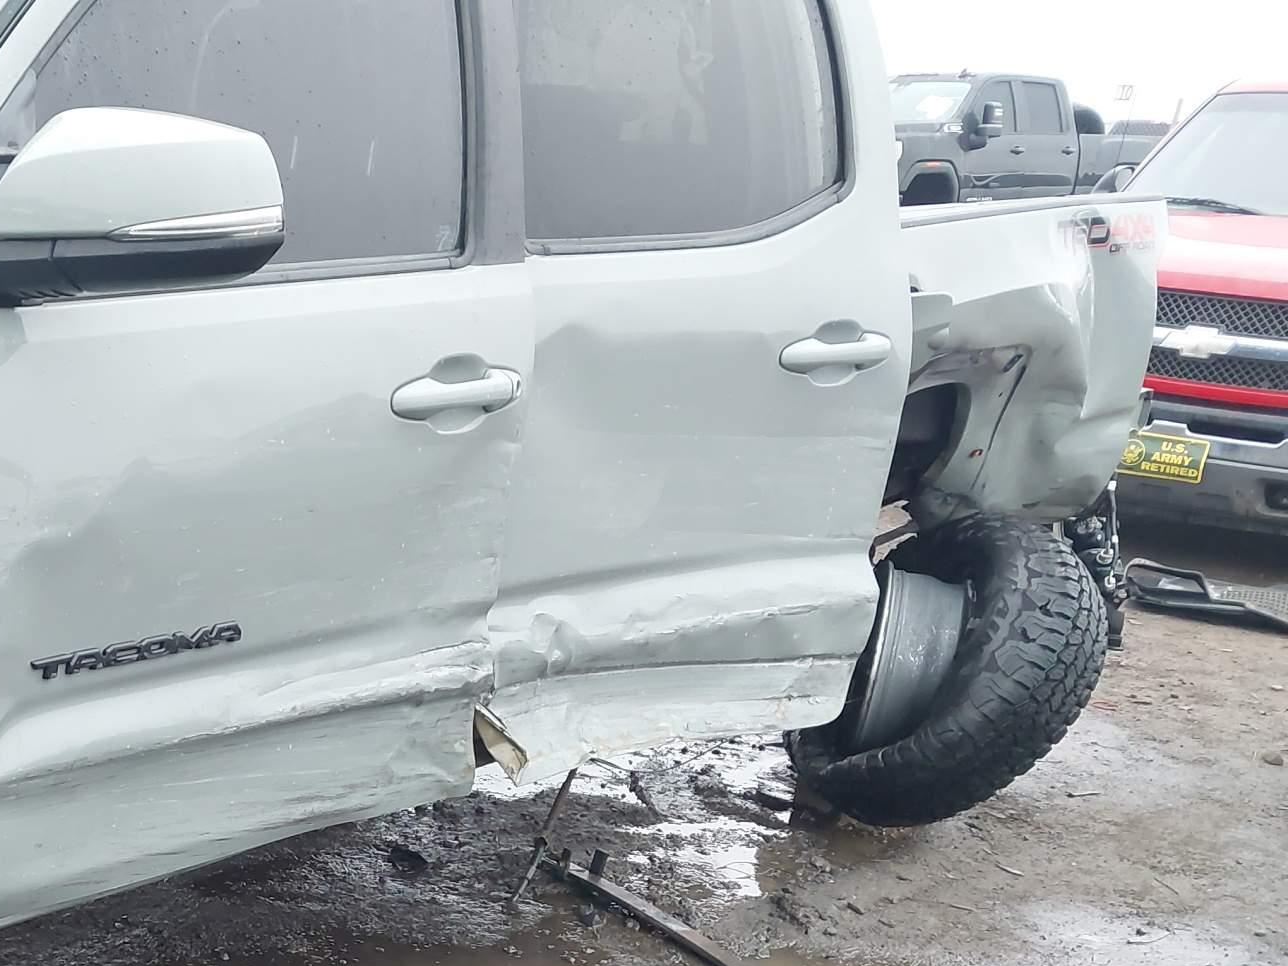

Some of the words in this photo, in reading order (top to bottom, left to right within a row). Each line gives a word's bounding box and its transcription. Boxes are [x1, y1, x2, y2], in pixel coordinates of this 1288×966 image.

[1161, 441, 1188, 454] U.S.
[1151, 451, 1193, 466] ARMY
[1140, 461, 1199, 477] RETIRED
[30, 619, 242, 680] TACOMA
